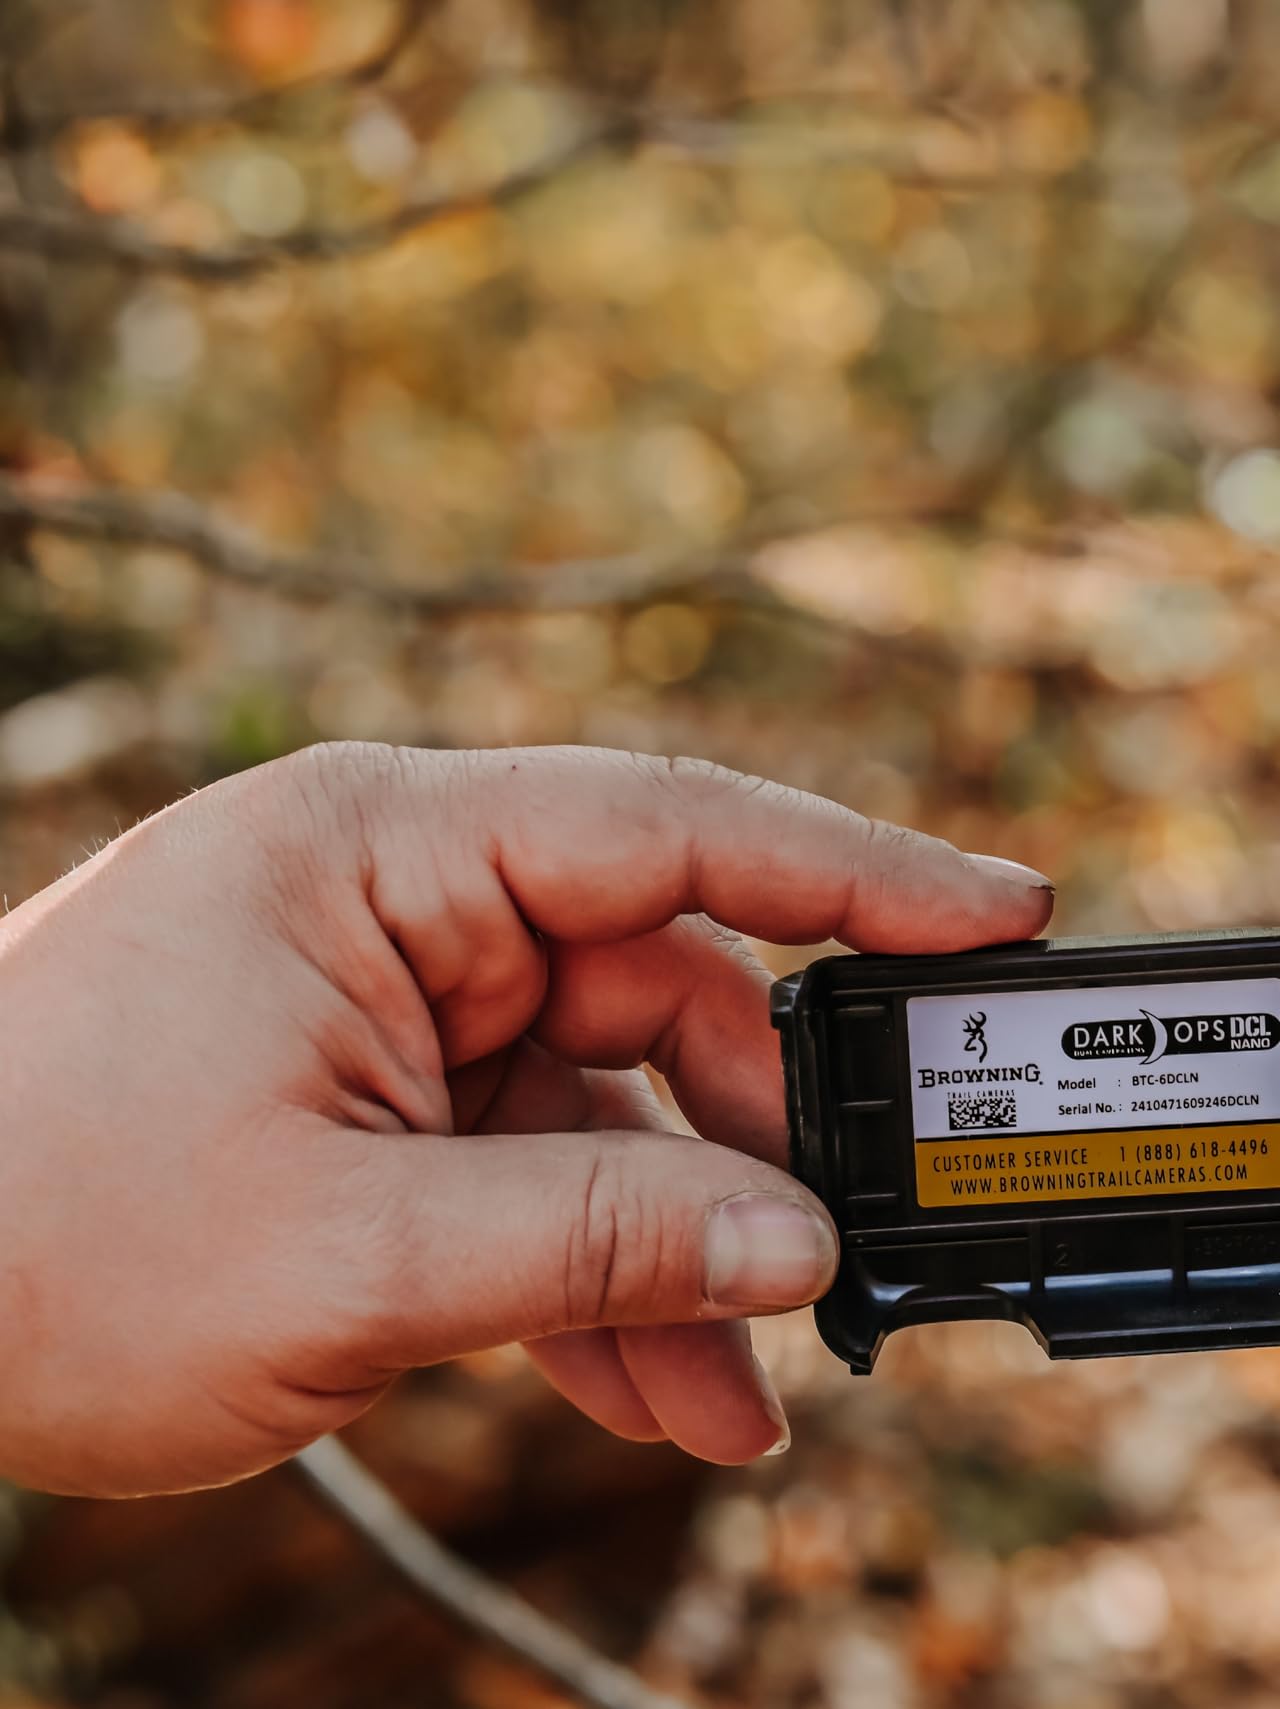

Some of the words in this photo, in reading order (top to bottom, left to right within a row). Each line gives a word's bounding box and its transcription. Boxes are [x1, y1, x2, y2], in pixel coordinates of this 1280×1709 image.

[1073, 1023, 1144, 1048] DARK
[1174, 1018, 1225, 1043] OPS
[1230, 1015, 1271, 1038] DCL
[1230, 1037, 1271, 1050] NANO
[917, 1063, 1041, 1088] BROWNING
[1057, 1077, 1096, 1090] Model
[1131, 1072, 1199, 1087] BTC-6DCLN
[947, 1091, 971, 1099] TRAIL
[976, 1089, 1015, 1098] CAMERAS
[1058, 1103, 1092, 1116] Serial
[1131, 1094, 1260, 1112] 2410471609246DCLN
[933, 1151, 1017, 1173] CUSTOMER
[1025, 1148, 1088, 1169] SERVICE
[1119, 1146, 1125, 1162] 1
[1135, 1142, 1181, 1163] (888)
[1190, 1139, 1269, 1159] 618-4496
[950, 1164, 1248, 1196] WWW.BROWNINGTRAILCAMERAS.COM
